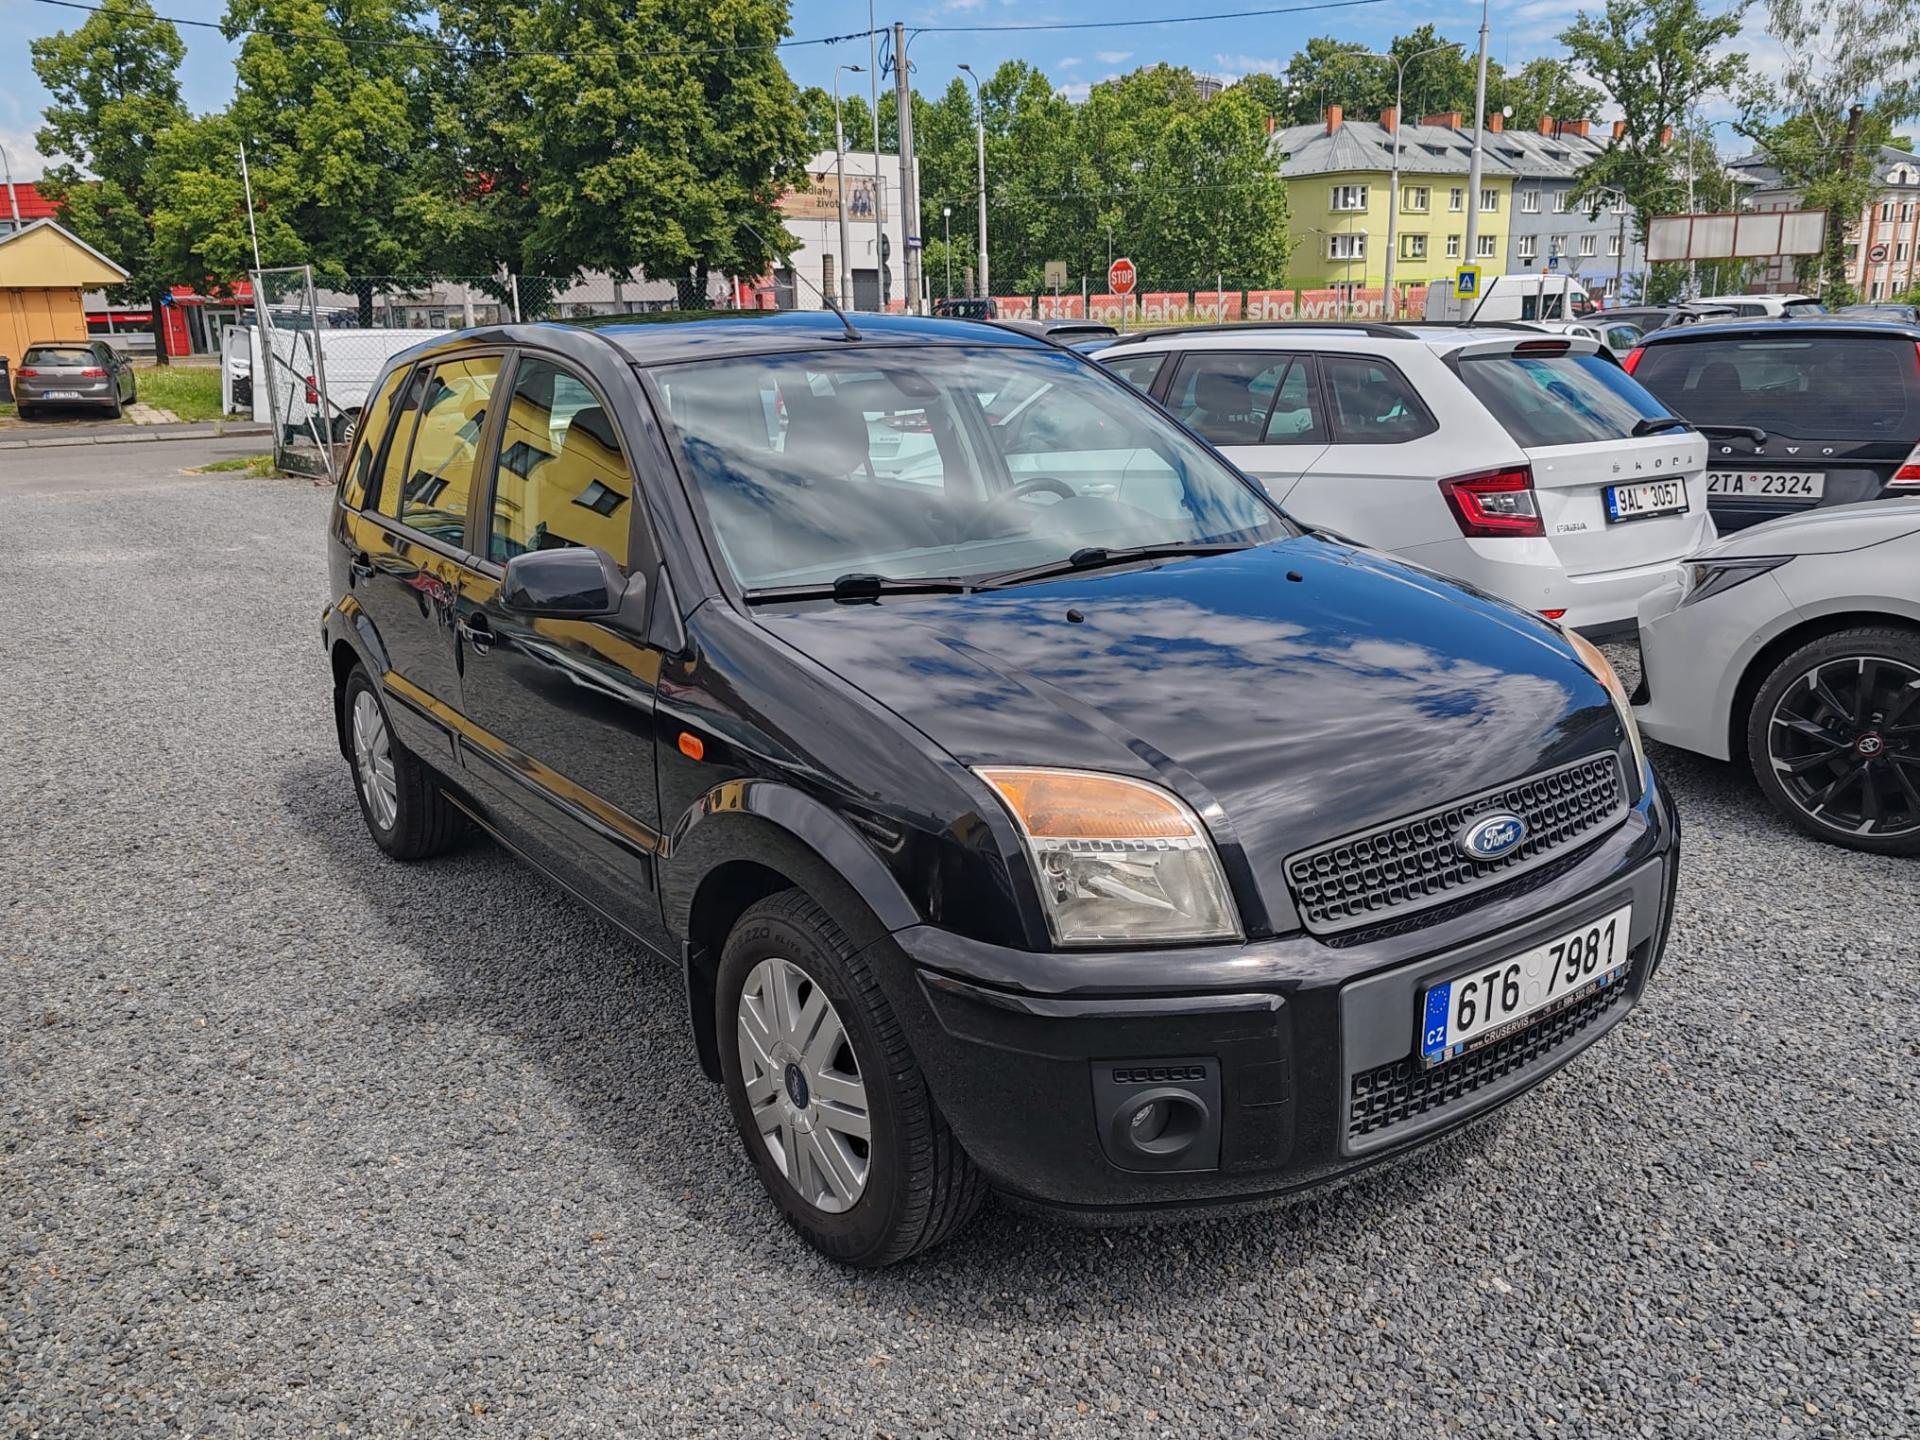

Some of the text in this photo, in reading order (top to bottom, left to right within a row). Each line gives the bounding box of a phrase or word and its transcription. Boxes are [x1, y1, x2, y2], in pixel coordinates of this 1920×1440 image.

[1111, 270, 1133, 285] STOP
[1721, 446, 1834, 455] OLVO
[1706, 474, 1813, 495] 2TA 2324
[1618, 482, 1678, 512] 9AL 3057
[1483, 823, 1516, 850] Ford
[1456, 917, 1617, 1032] 6T6 7981
[1426, 1025, 1445, 1047] CZ
